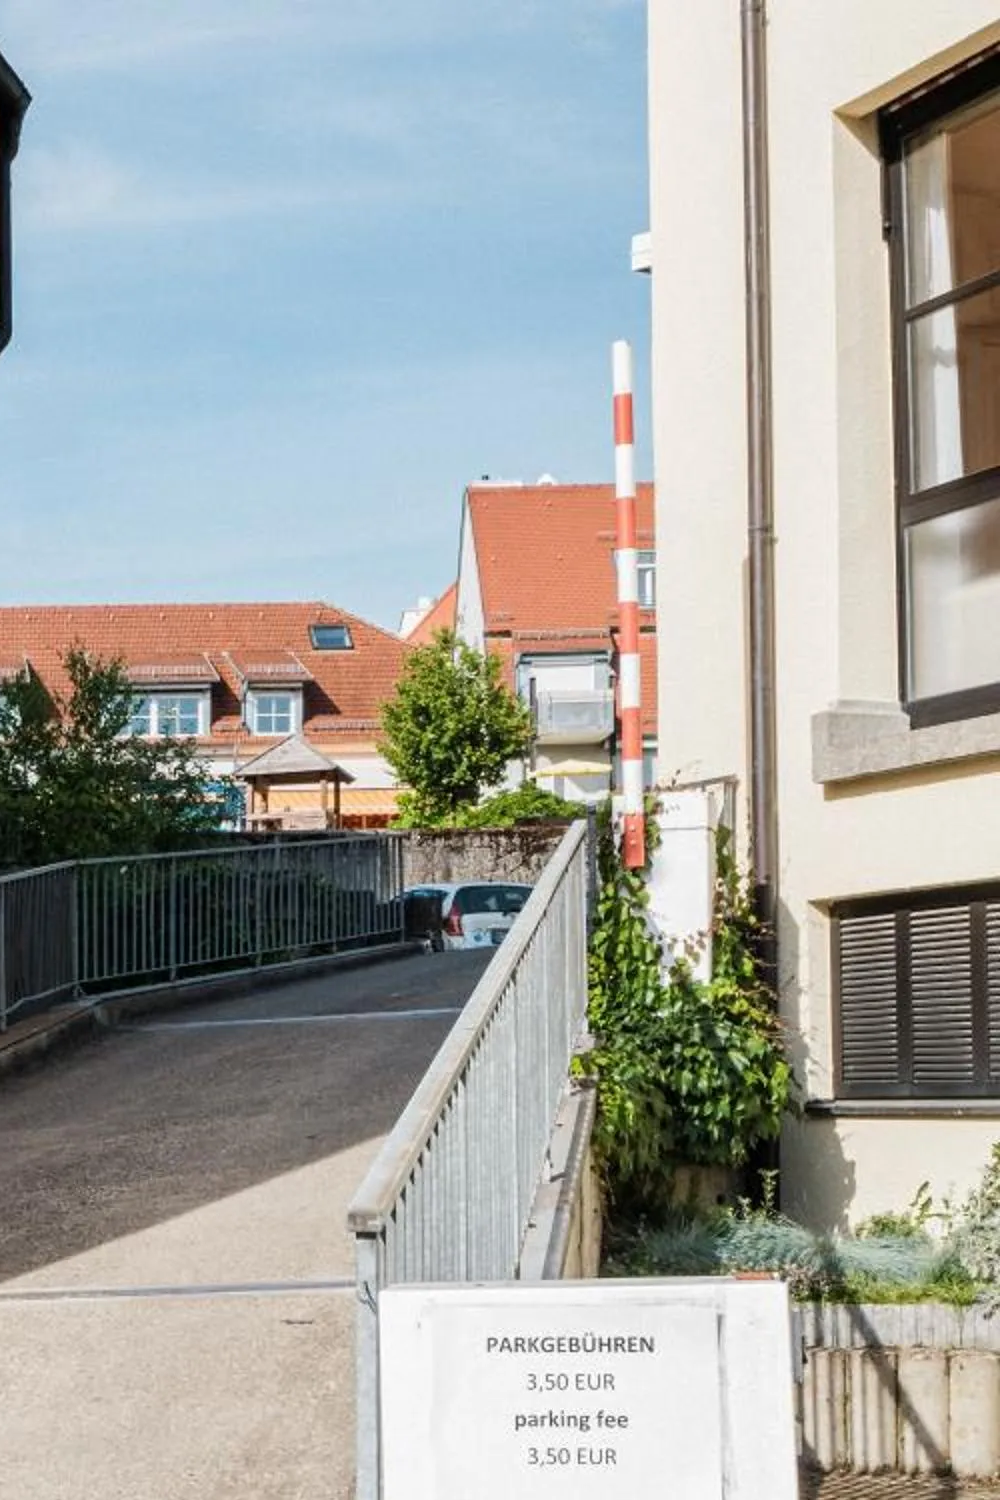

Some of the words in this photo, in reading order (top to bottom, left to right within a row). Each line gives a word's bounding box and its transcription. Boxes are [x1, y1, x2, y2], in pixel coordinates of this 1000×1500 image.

[487, 1332, 654, 1353] PARKGEBÜHREN
[526, 1374, 569, 1392] 3,50
[575, 1374, 615, 1390] EUR
[515, 1410, 590, 1432] parking
[596, 1410, 629, 1428] fee
[527, 1448, 570, 1466] 3,50
[577, 1448, 617, 1465] EUR
